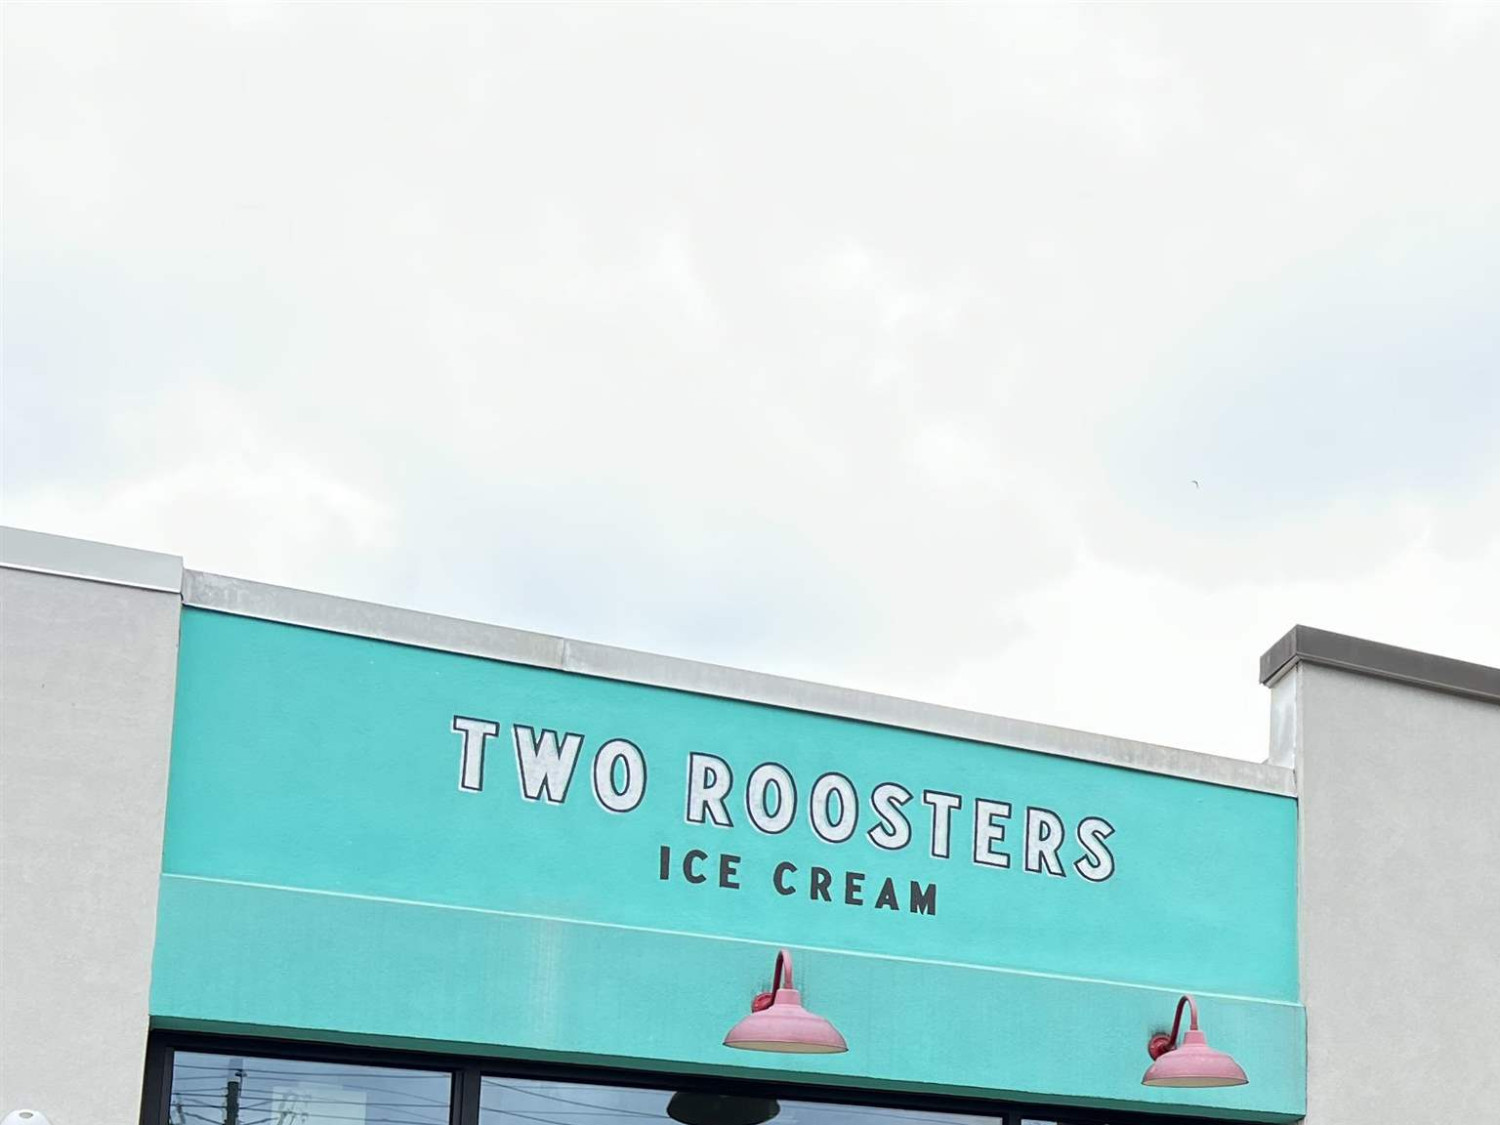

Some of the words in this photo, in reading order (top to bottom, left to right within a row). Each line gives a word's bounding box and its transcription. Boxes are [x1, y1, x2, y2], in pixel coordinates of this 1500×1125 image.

[451, 715, 648, 814] TWO
[686, 751, 1116, 882] ROOSTERS
[660, 845, 741, 890] ICE
[773, 861, 937, 916] CREAM
